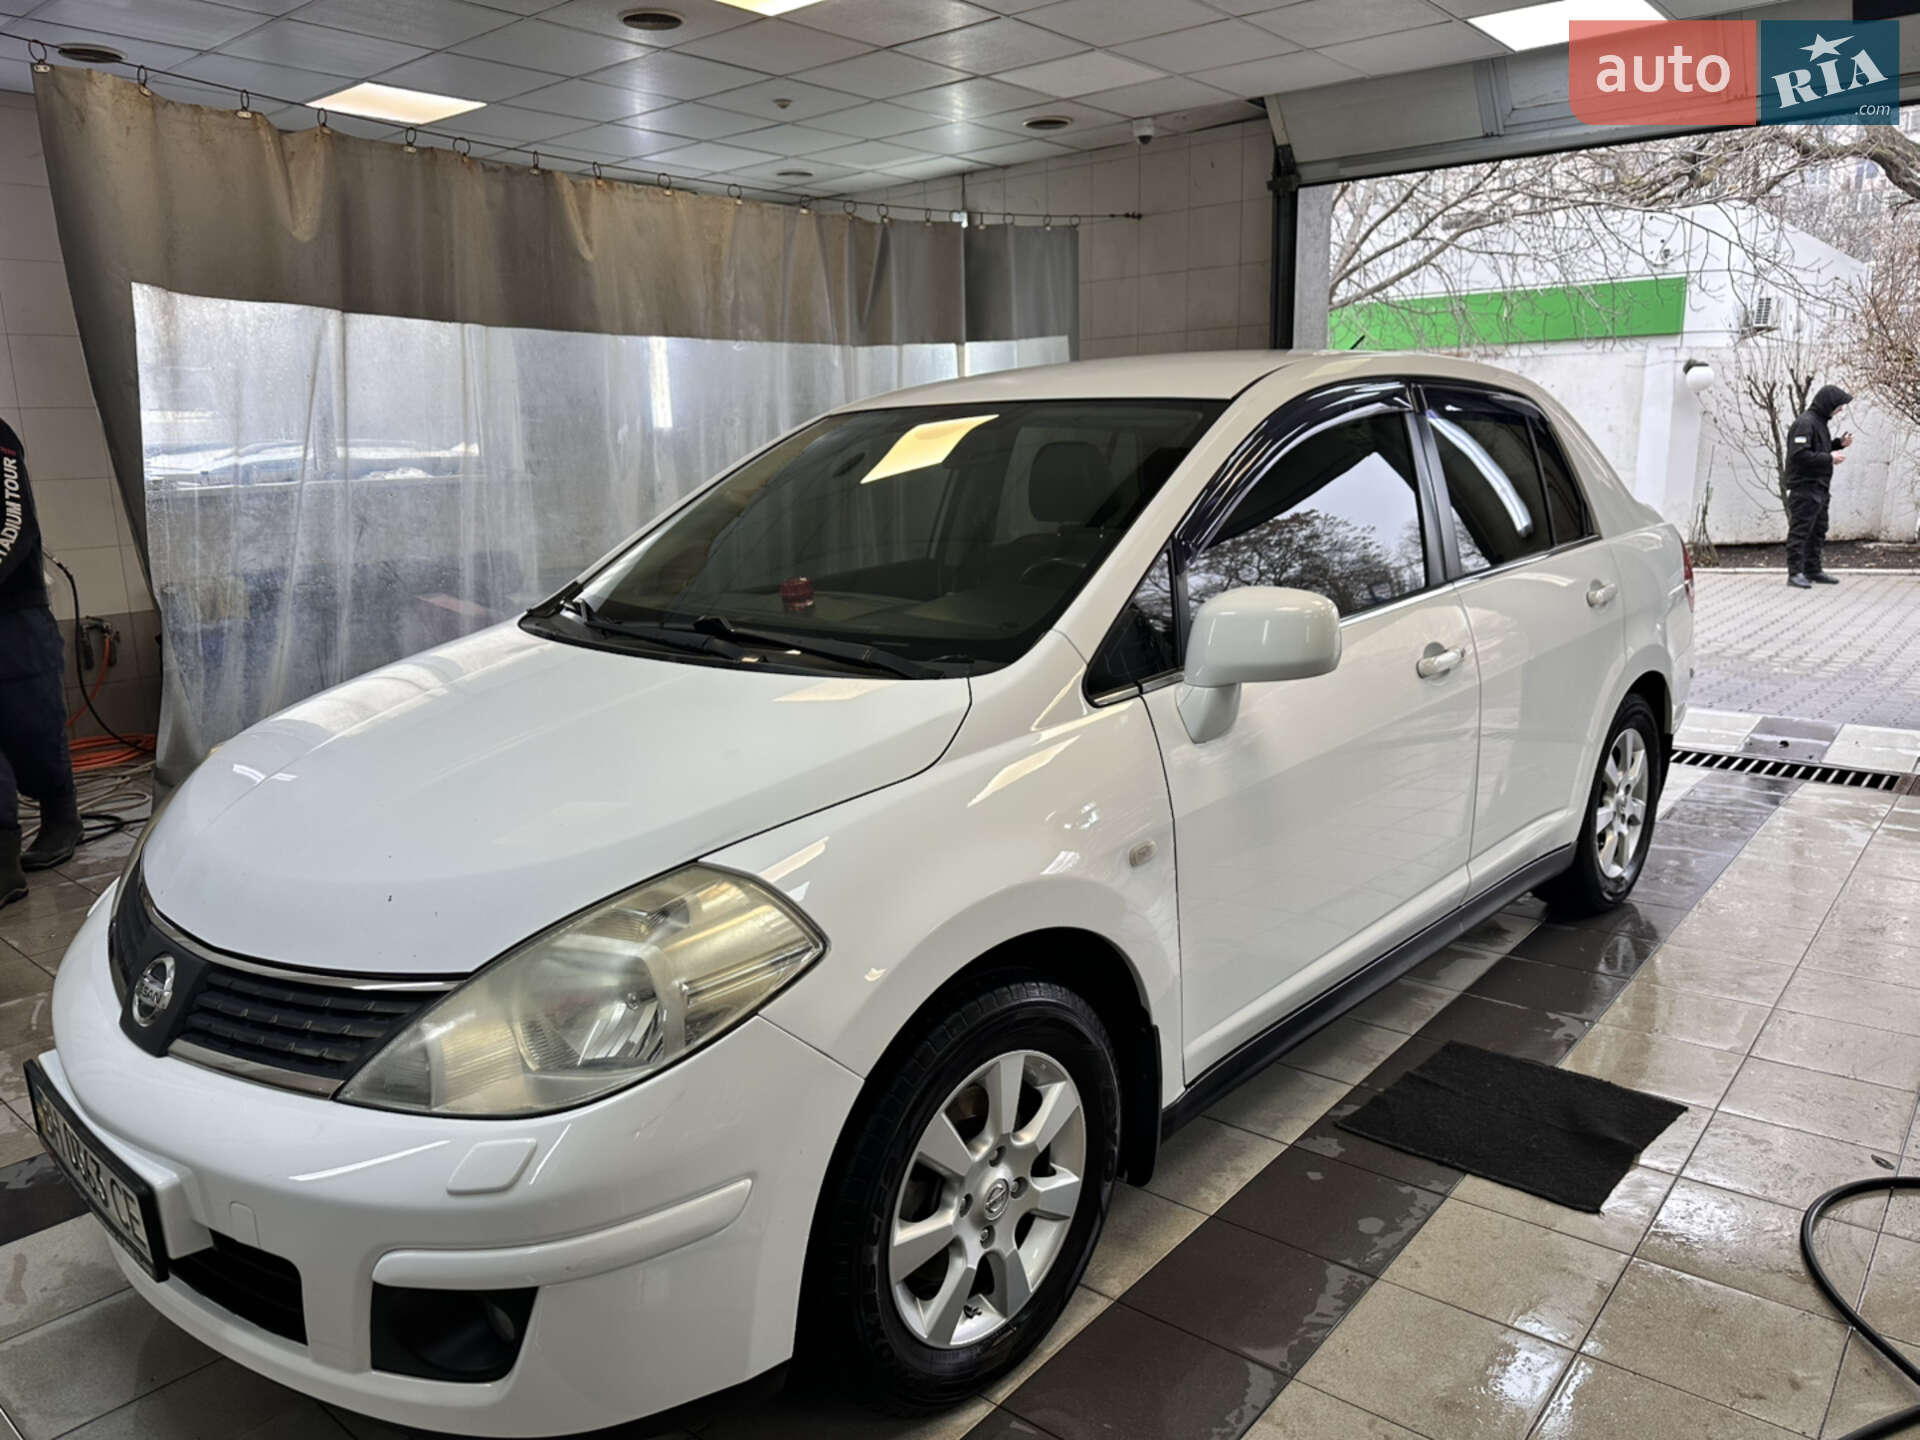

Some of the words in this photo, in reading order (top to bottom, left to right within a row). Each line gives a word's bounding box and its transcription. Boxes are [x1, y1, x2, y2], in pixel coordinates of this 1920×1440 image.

[3, 456, 22, 500] TOUR
[0, 500, 23, 565] ADIUM
[110, 1177, 148, 1250] CE
